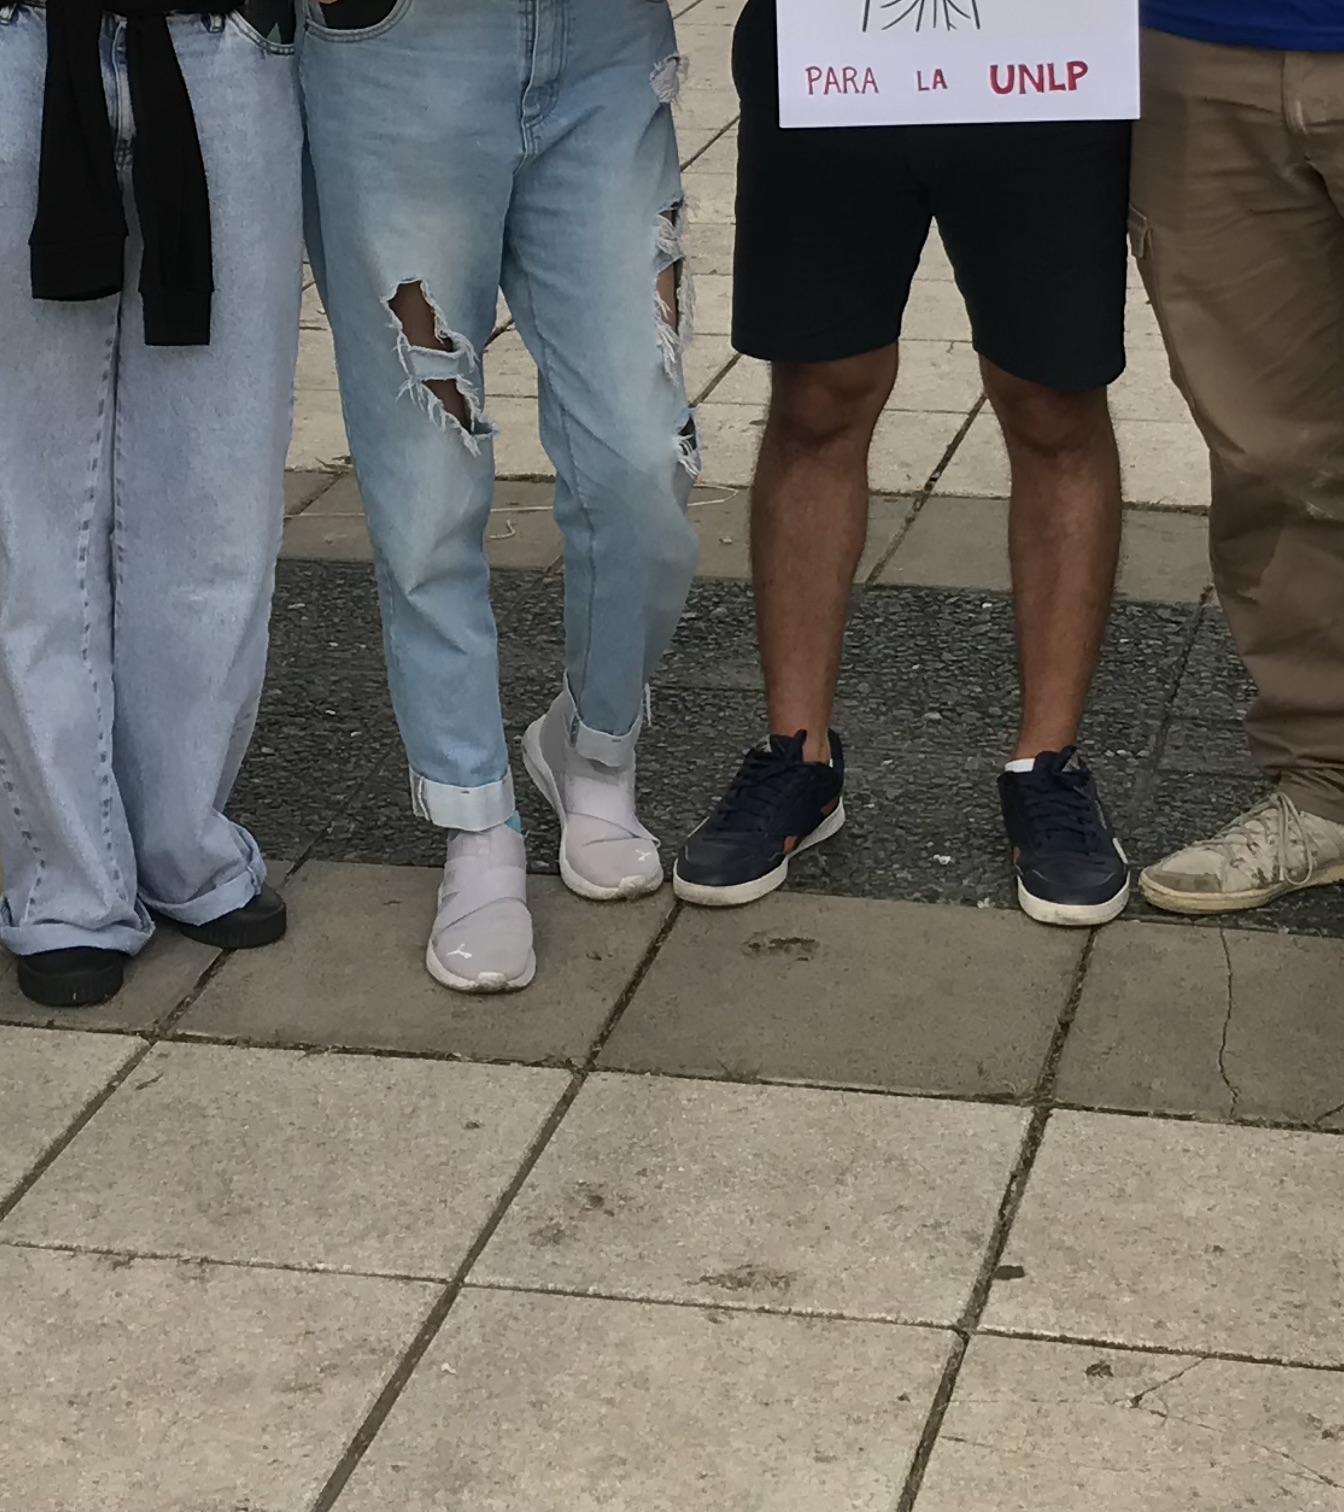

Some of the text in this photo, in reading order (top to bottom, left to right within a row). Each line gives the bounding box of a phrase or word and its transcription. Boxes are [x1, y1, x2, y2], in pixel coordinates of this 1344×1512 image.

[806, 60, 1089, 95] PARA LA UNLP
